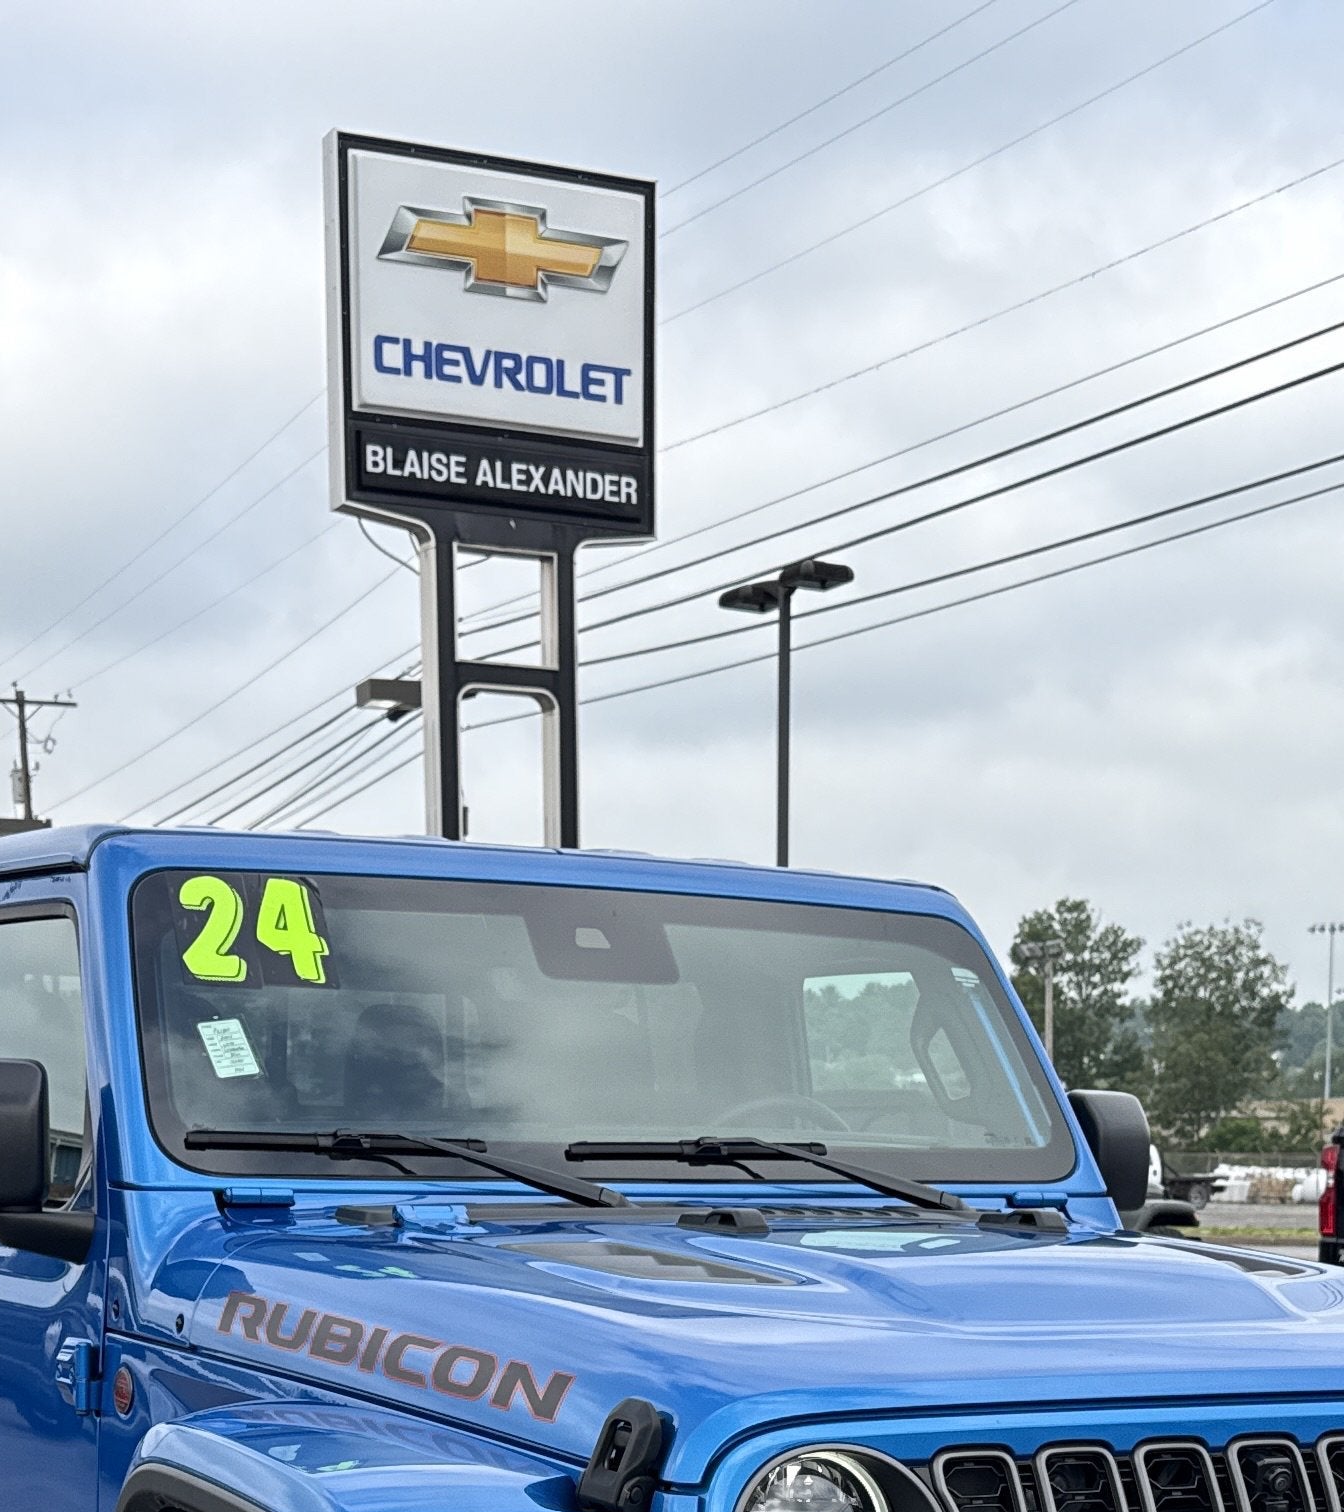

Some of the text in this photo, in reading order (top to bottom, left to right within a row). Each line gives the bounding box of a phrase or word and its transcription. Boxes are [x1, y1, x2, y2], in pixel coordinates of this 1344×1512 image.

[374, 334, 632, 405] CHEVROLET
[365, 444, 638, 505] BLAISE ALEXANDER
[178, 875, 330, 984] 24
[217, 1291, 576, 1423] RUBICON
